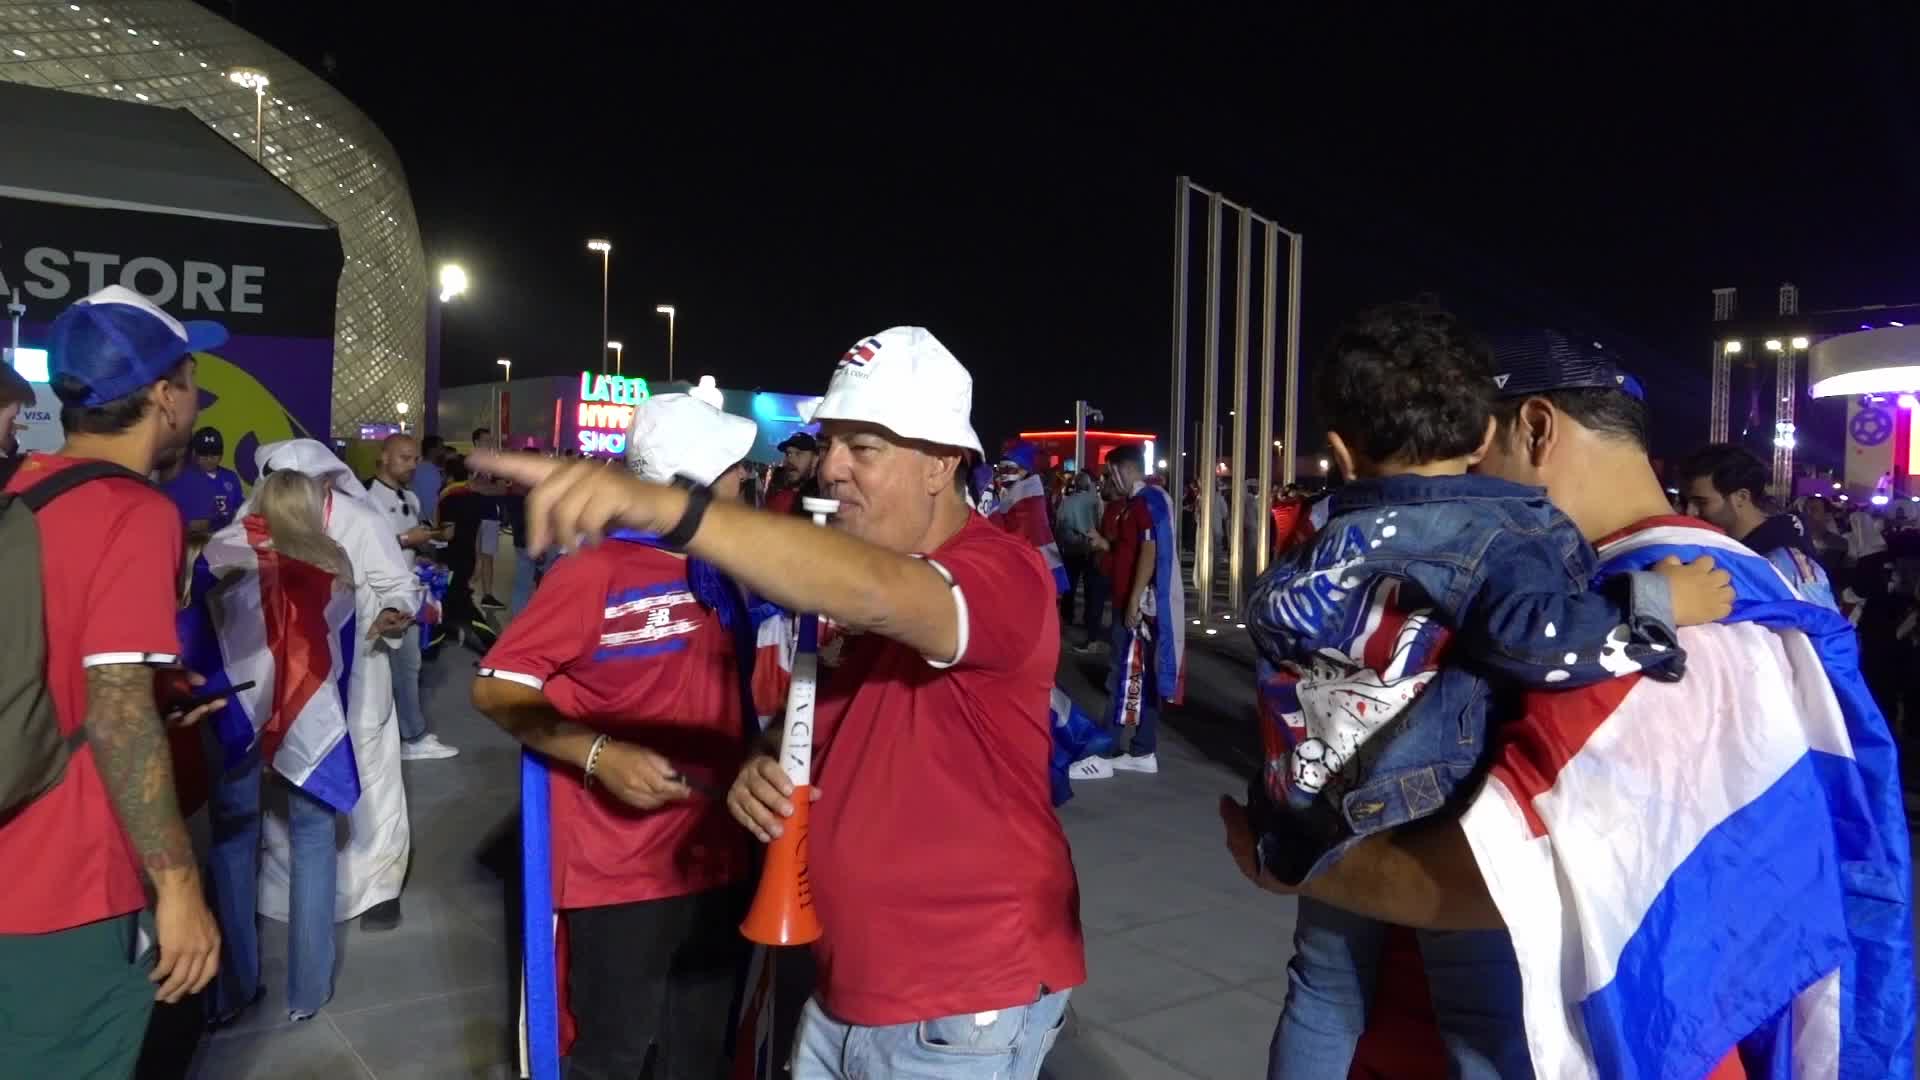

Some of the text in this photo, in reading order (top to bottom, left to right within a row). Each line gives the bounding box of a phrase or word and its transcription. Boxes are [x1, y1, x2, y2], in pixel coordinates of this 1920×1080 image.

[24, 246, 265, 314] STORE
[24, 411, 51, 421] VISA
[578, 430, 626, 453] SHO
[1125, 672, 1141, 712] RICA
